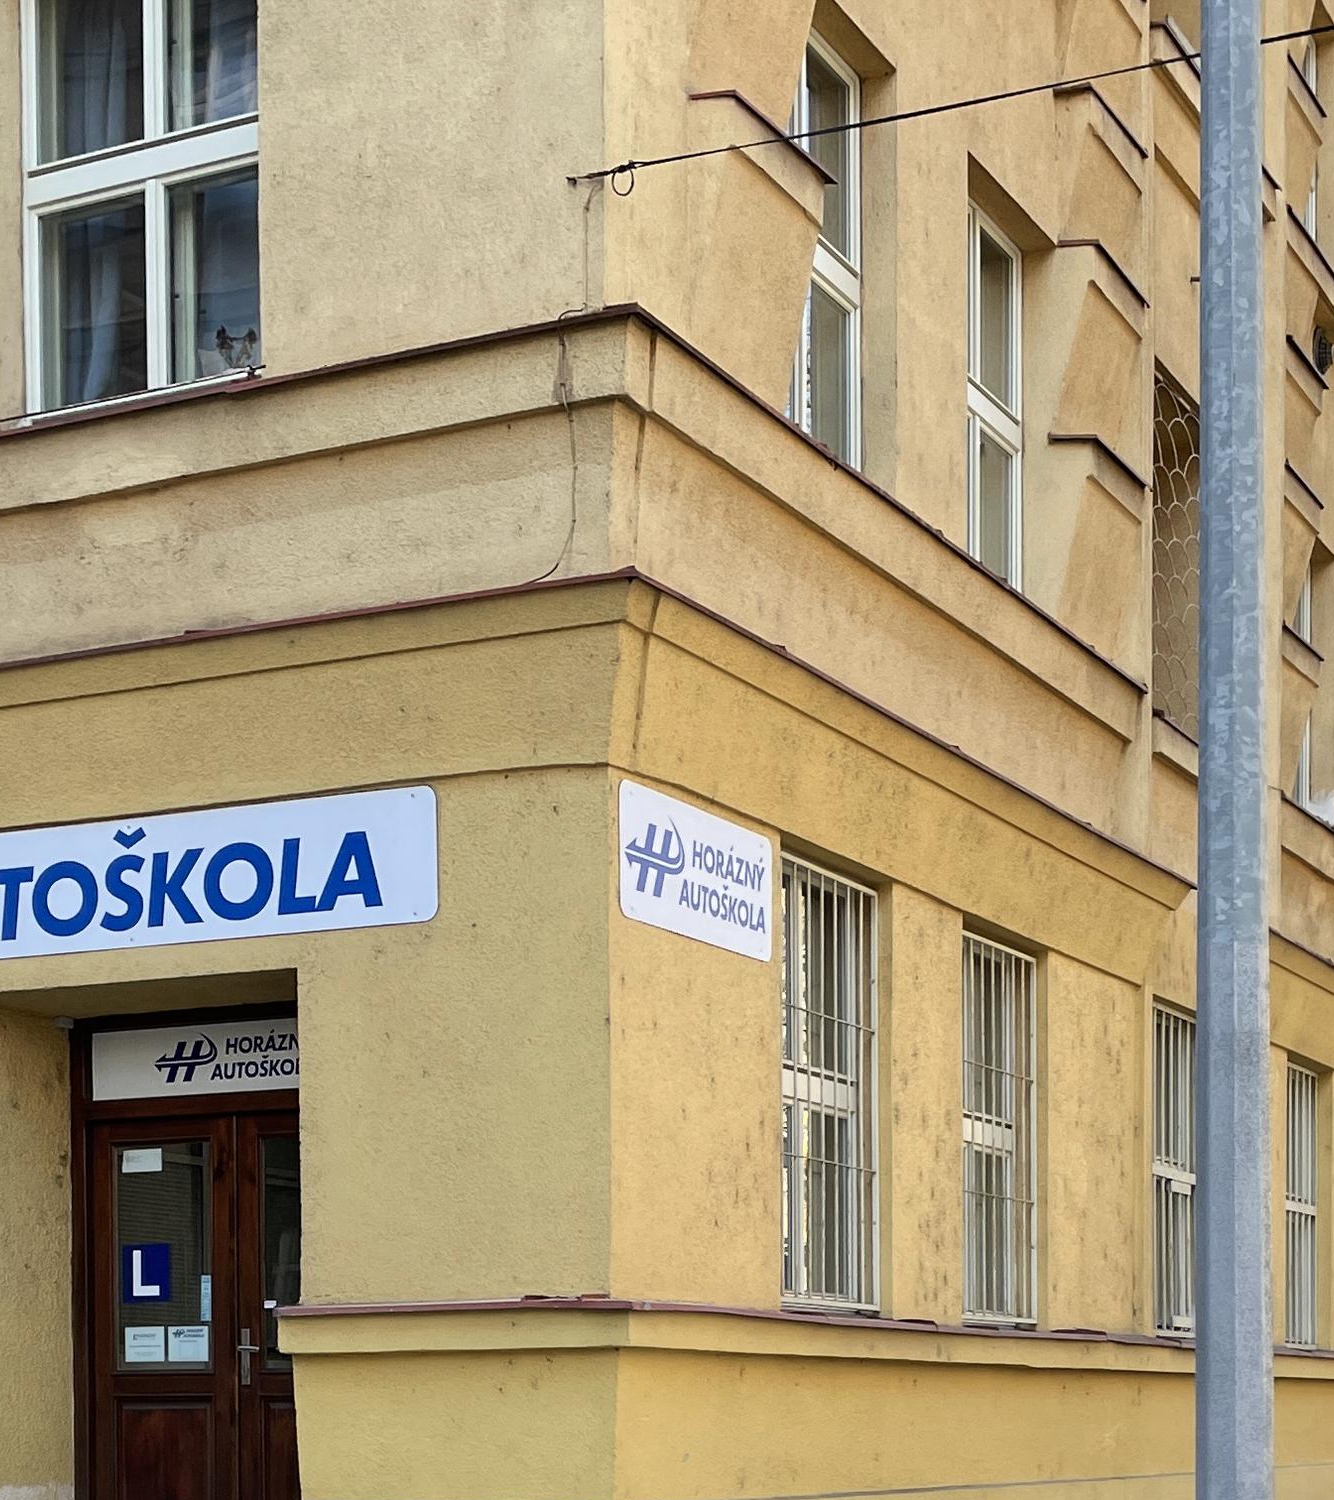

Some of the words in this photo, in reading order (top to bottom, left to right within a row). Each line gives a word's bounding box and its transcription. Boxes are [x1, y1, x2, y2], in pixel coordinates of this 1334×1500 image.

[692, 840, 765, 892] HORÁZNÝ
[679, 879, 767, 934] AUTOŠKOLA
[226, 1029, 299, 1055] HORÁZN
[211, 1055, 299, 1080] AUTOŠKO
[132, 1249, 161, 1297] L
